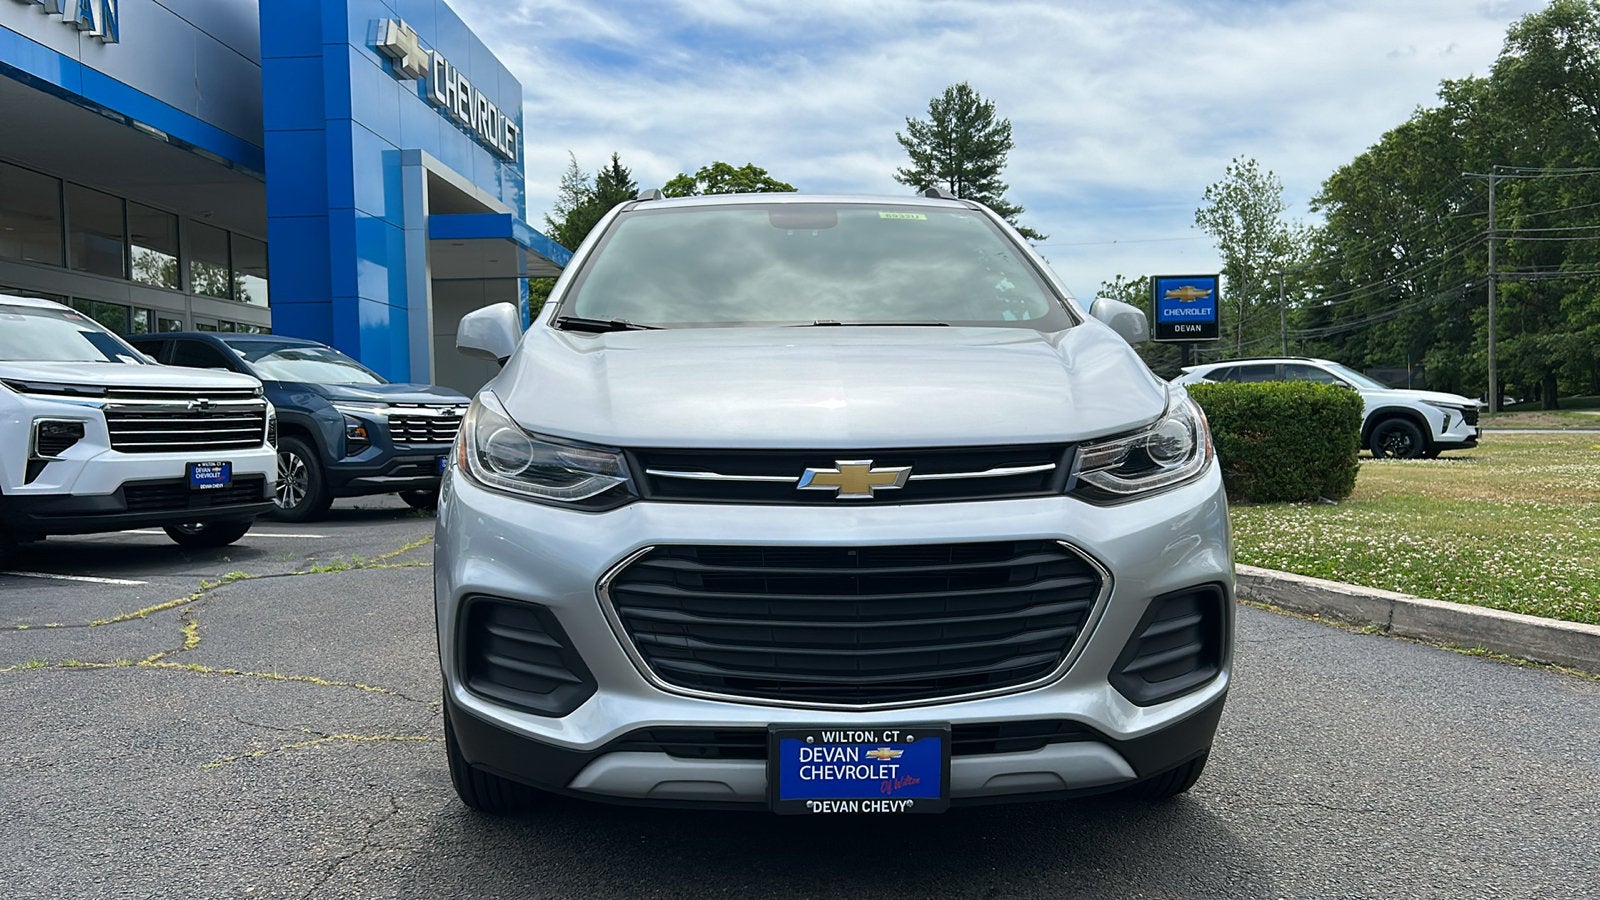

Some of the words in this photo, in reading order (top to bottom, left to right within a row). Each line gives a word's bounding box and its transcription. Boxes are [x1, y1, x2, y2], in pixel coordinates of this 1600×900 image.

[429, 50, 520, 163] CHEVROLET
[1164, 308, 1212, 316] CHEVROLET
[821, 731, 878, 743] WILTON,
[883, 730, 900, 742] CT
[800, 747, 859, 763] DEVAN
[799, 764, 900, 780] CHEVROLET
[813, 800, 859, 813] DEVAN
[861, 800, 907, 813] CHEVY
